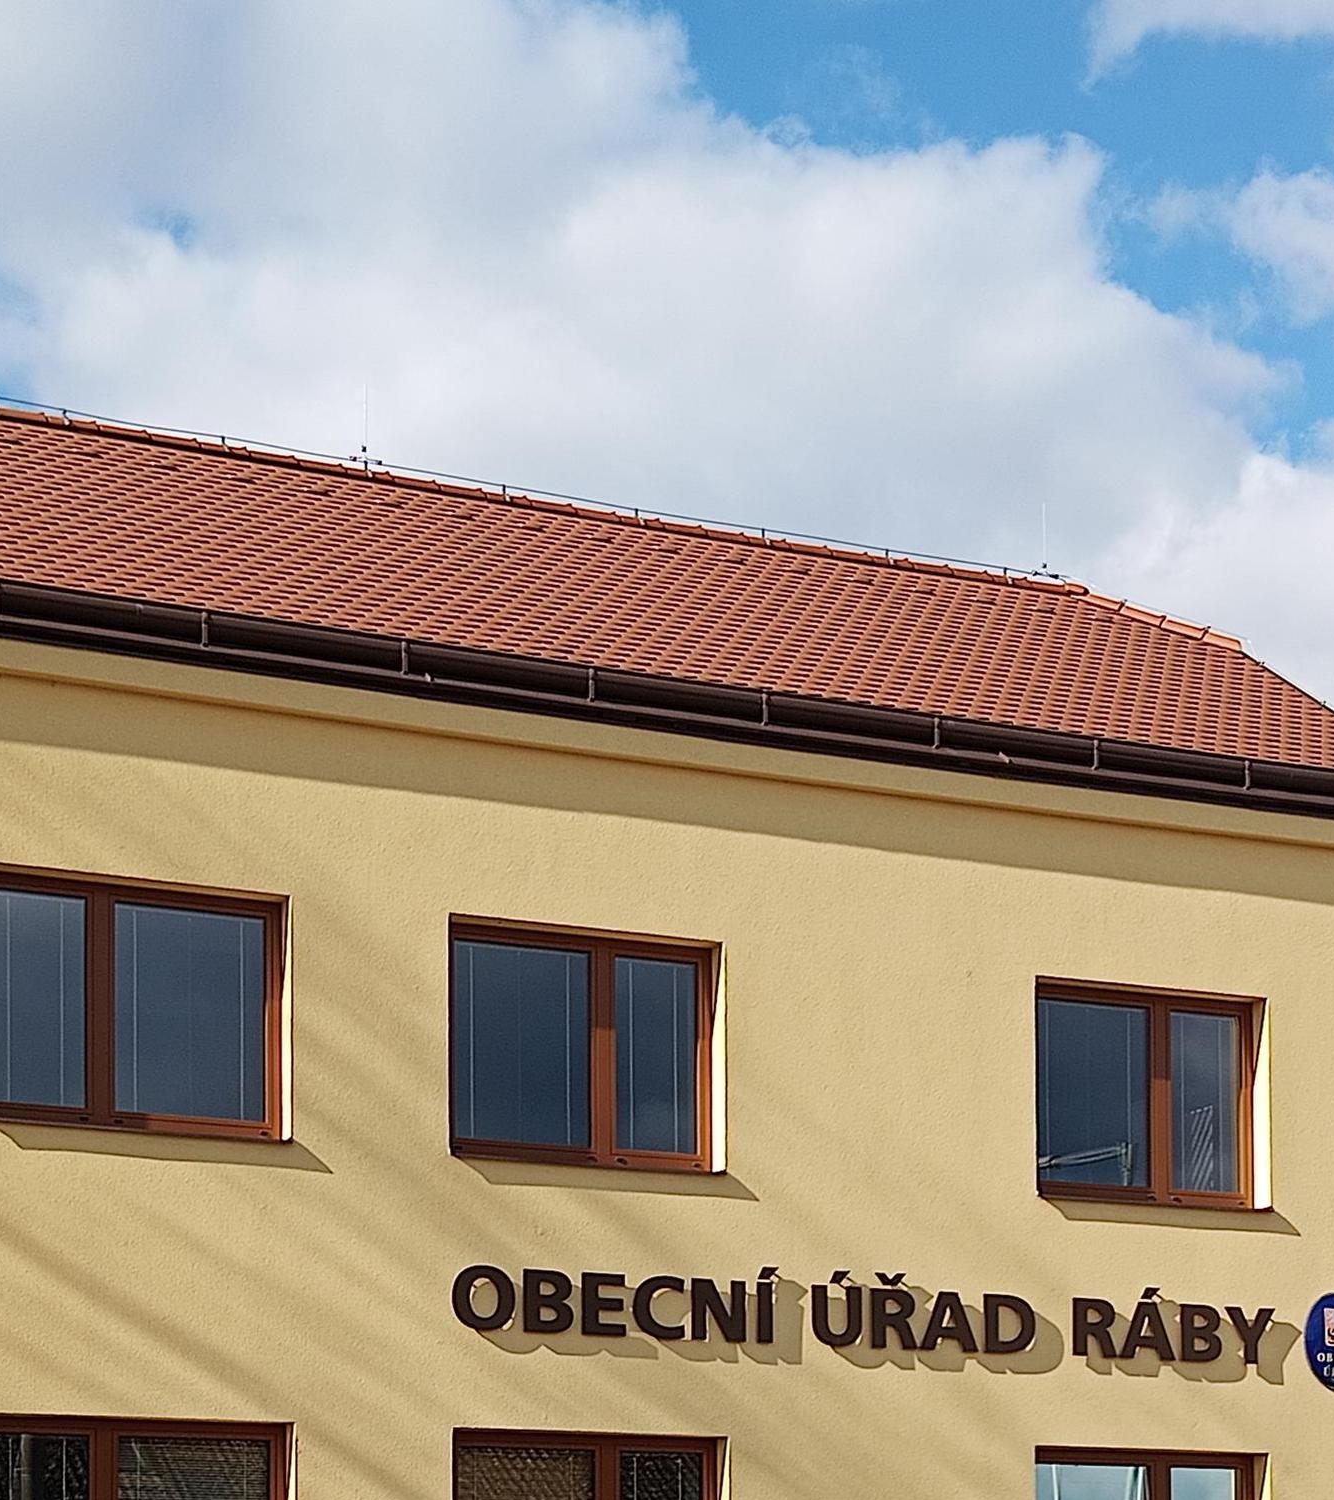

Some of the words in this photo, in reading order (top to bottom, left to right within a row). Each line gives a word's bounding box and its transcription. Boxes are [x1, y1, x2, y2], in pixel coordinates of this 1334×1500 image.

[452, 1265, 779, 1344] OBECNÍ
[811, 1270, 1036, 1354] ÚŘAD
[1072, 1286, 1276, 1365] RÁBY
